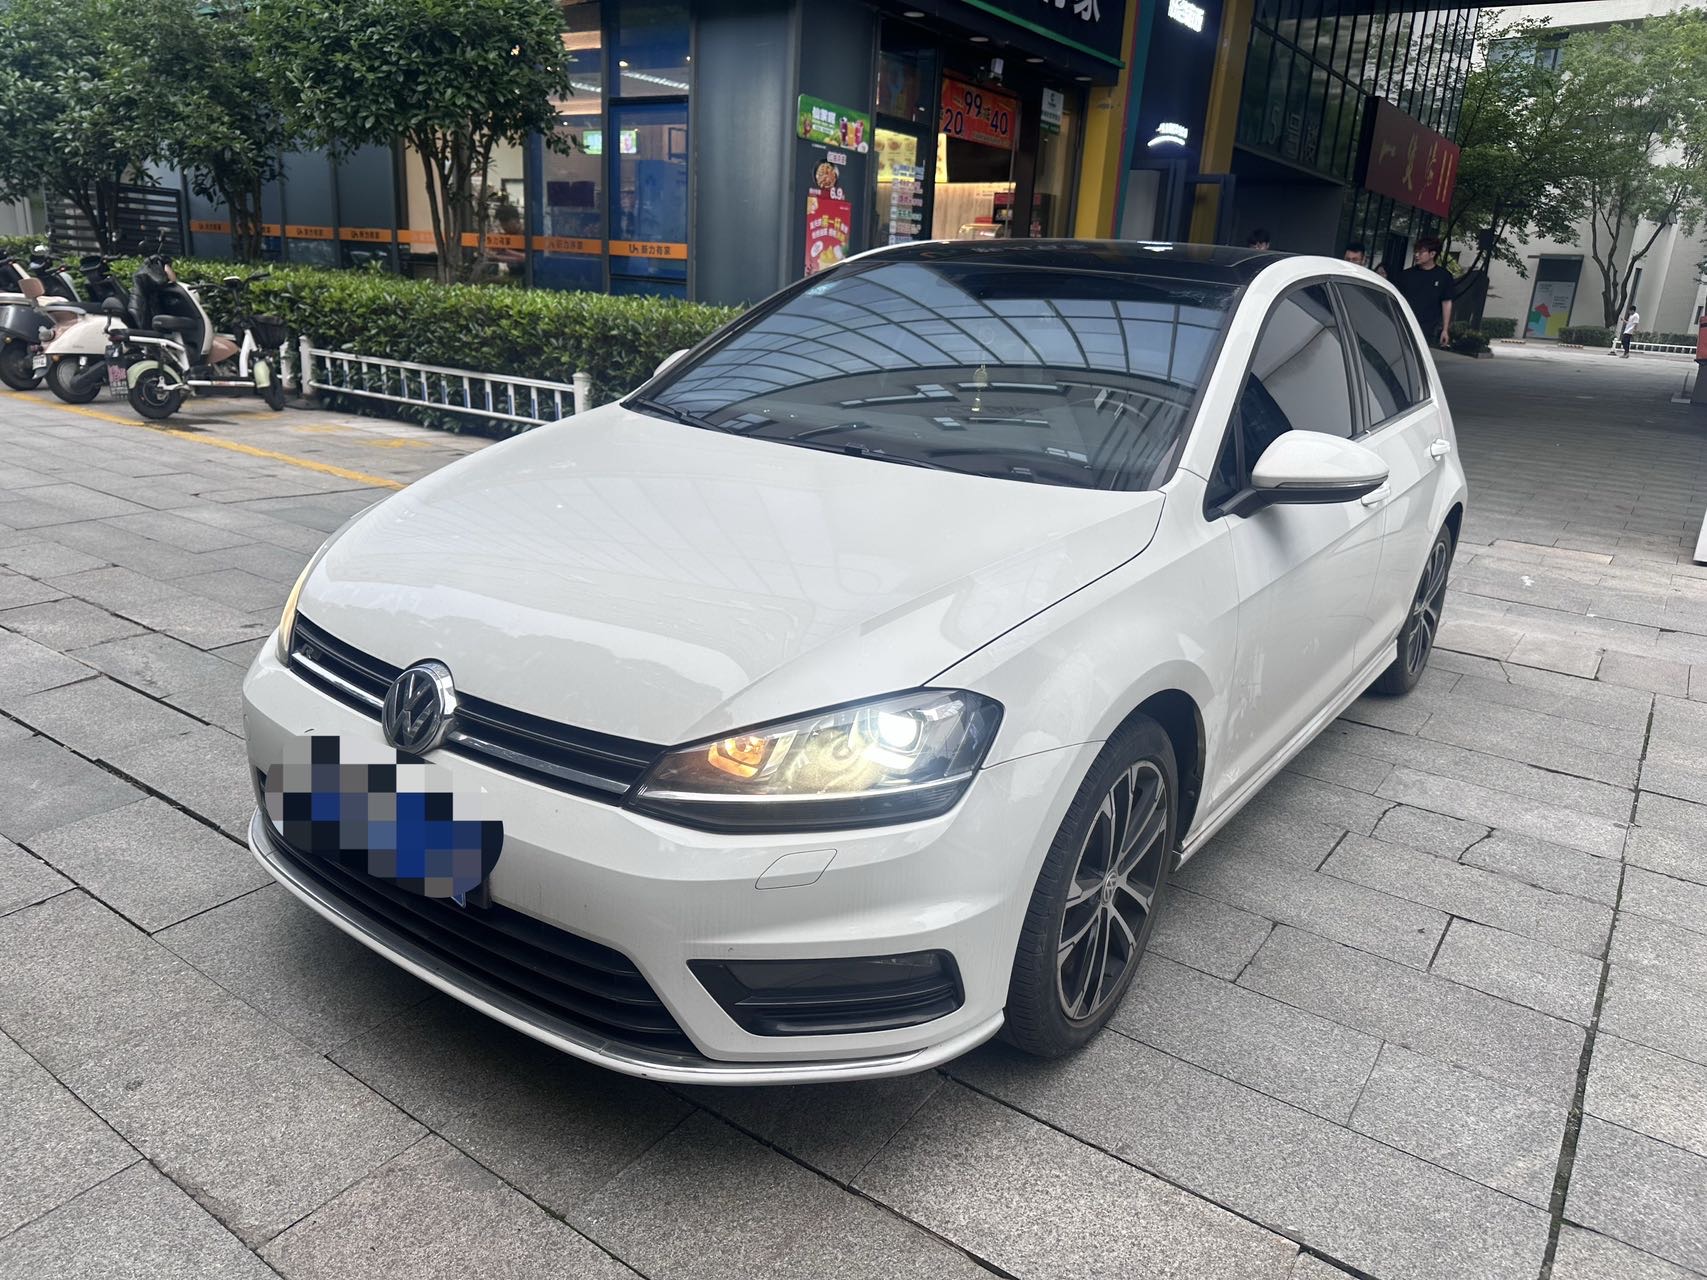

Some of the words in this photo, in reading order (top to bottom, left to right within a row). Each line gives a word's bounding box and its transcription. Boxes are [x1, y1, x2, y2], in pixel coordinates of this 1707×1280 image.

[964, 91, 982, 117] 99
[943, 108, 963, 135] 20
[991, 110, 1008, 135] 40
